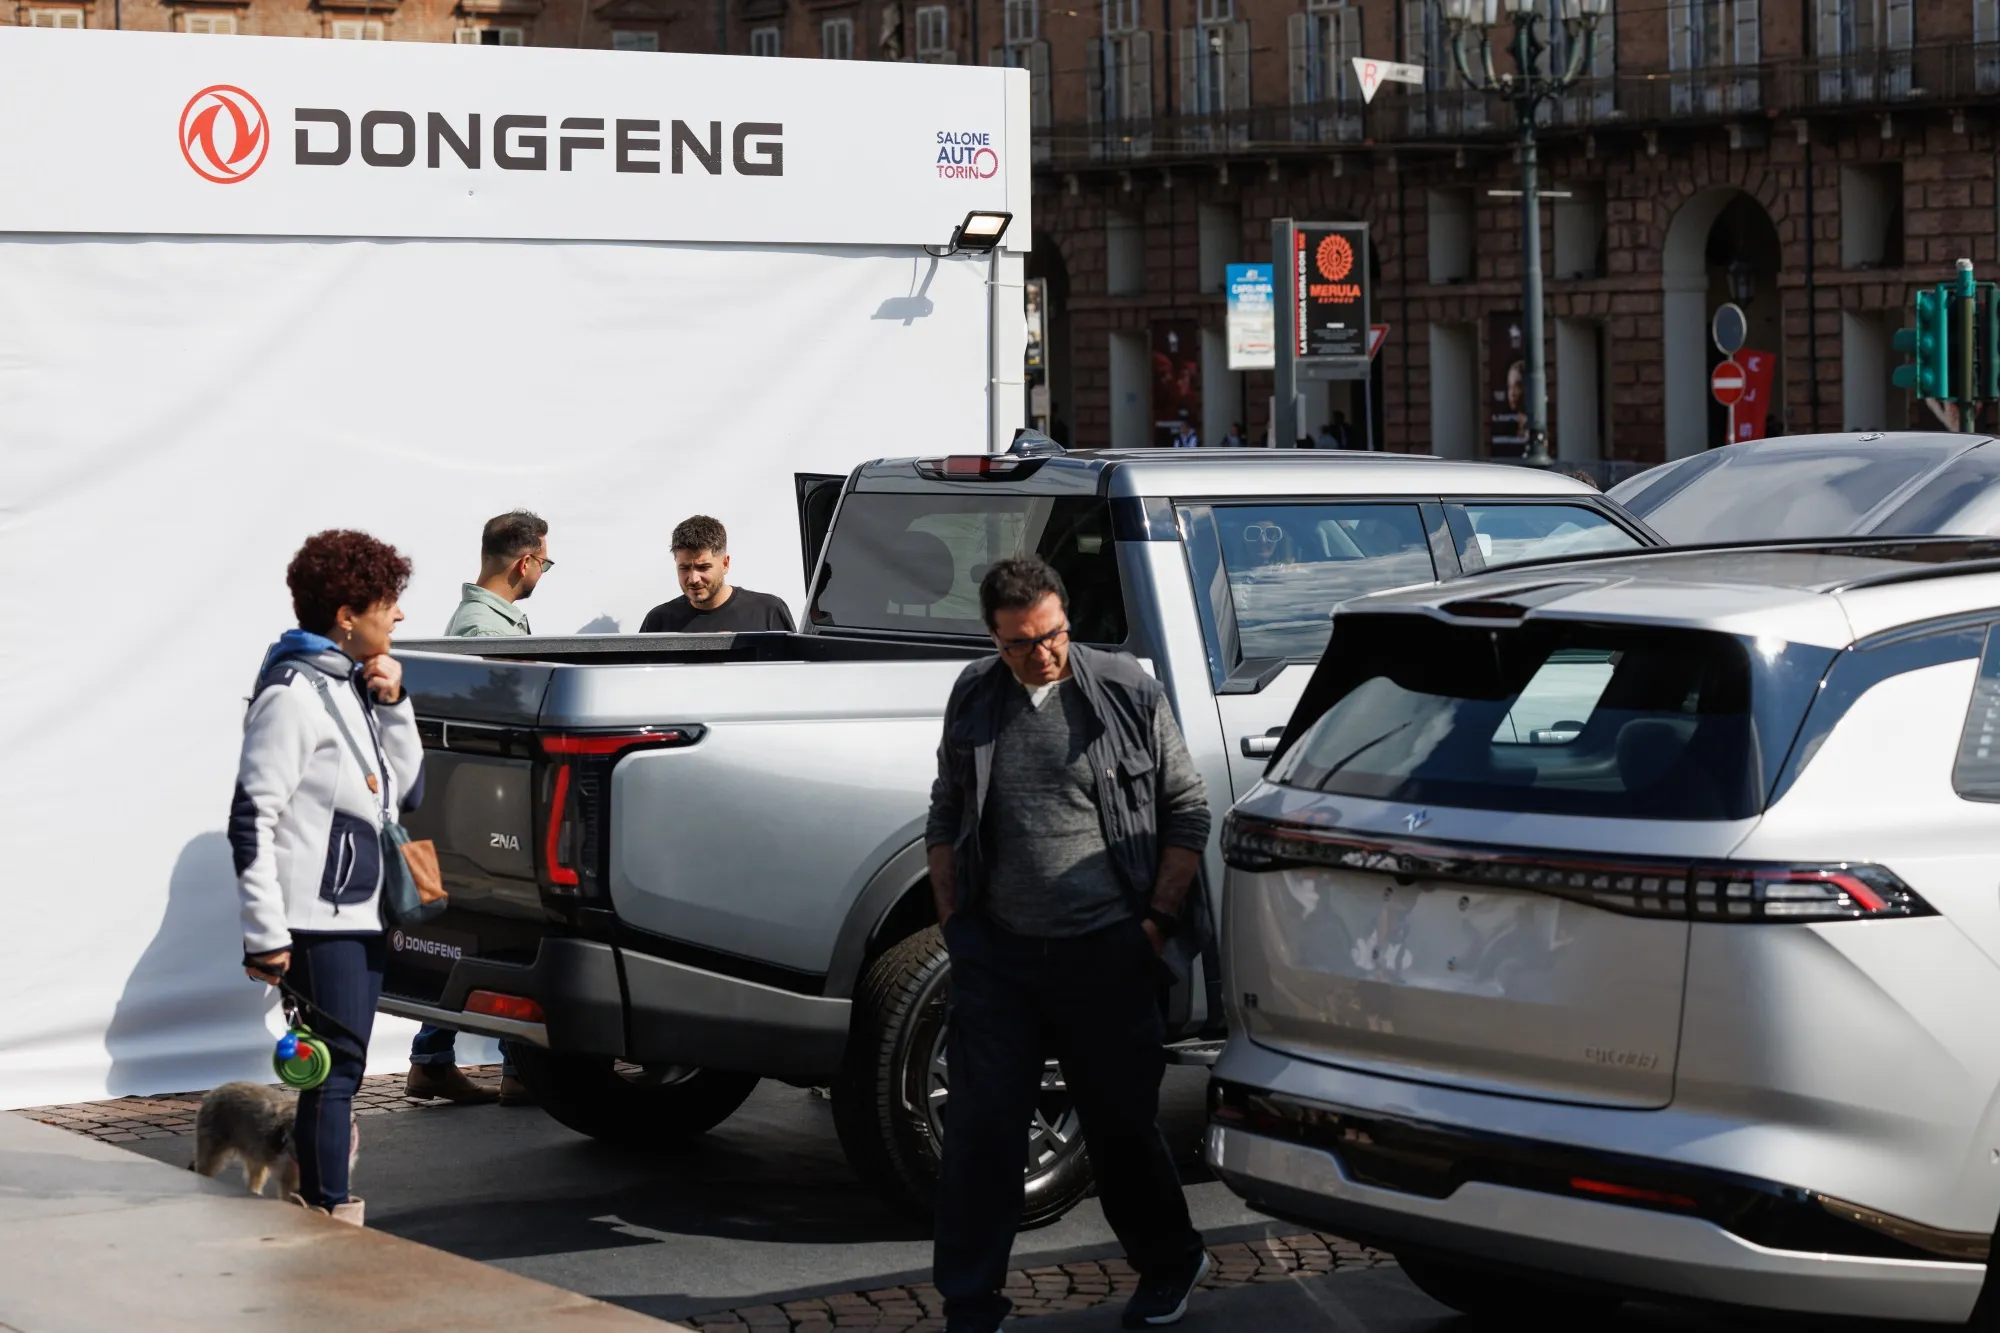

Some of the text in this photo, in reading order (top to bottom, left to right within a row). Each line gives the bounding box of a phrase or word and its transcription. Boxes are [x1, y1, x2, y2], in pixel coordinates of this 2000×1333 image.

[294, 107, 784, 176] DONGFENG
[936, 131, 990, 146] SALONE
[936, 146, 998, 177] AUTO
[1309, 284, 1361, 297] MERULA
[405, 936, 462, 959] DONGFENG
